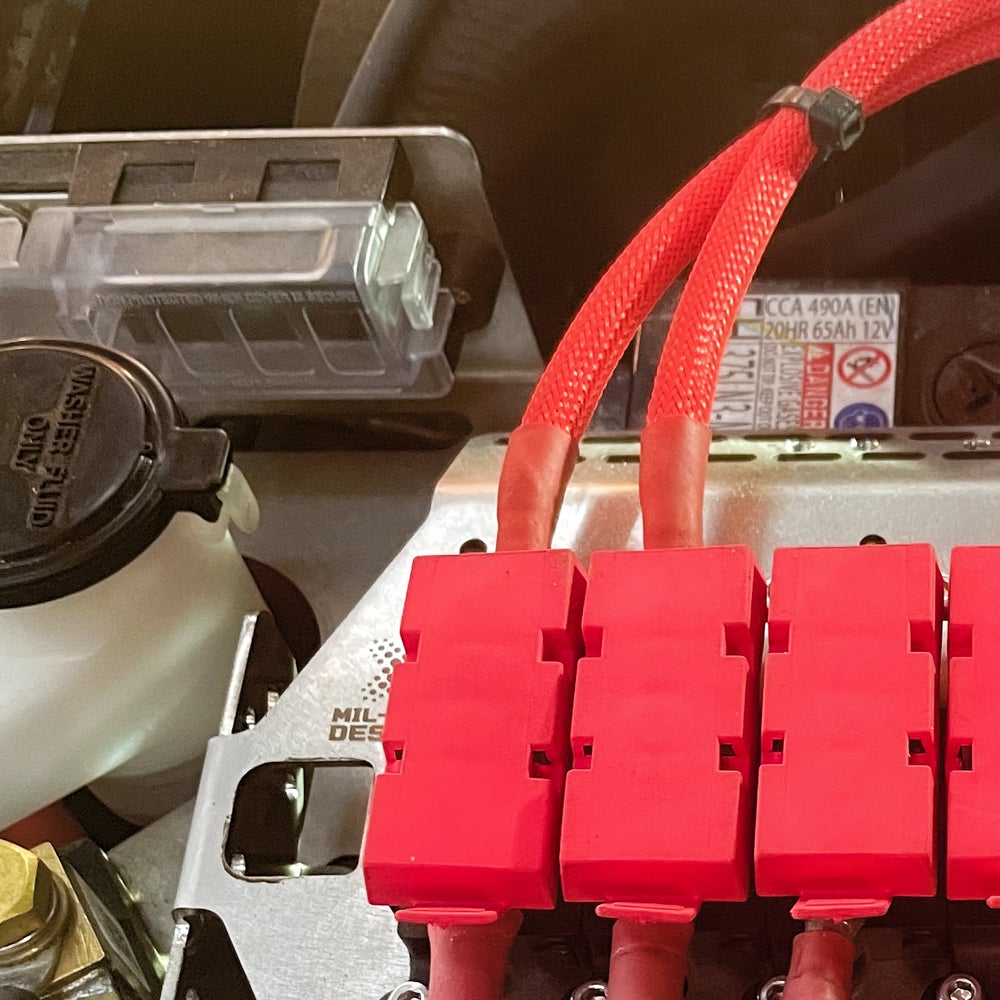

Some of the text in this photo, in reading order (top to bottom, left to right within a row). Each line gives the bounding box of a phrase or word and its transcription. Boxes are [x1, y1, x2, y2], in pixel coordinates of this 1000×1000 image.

[764, 296, 896, 319] CCA 490A (EN)
[765, 320, 892, 340] 20HR 65Ah 12V
[802, 364, 831, 430] DANGER
[15, 416, 50, 471] ONLY
[31, 364, 97, 529] WASHER FLUID
